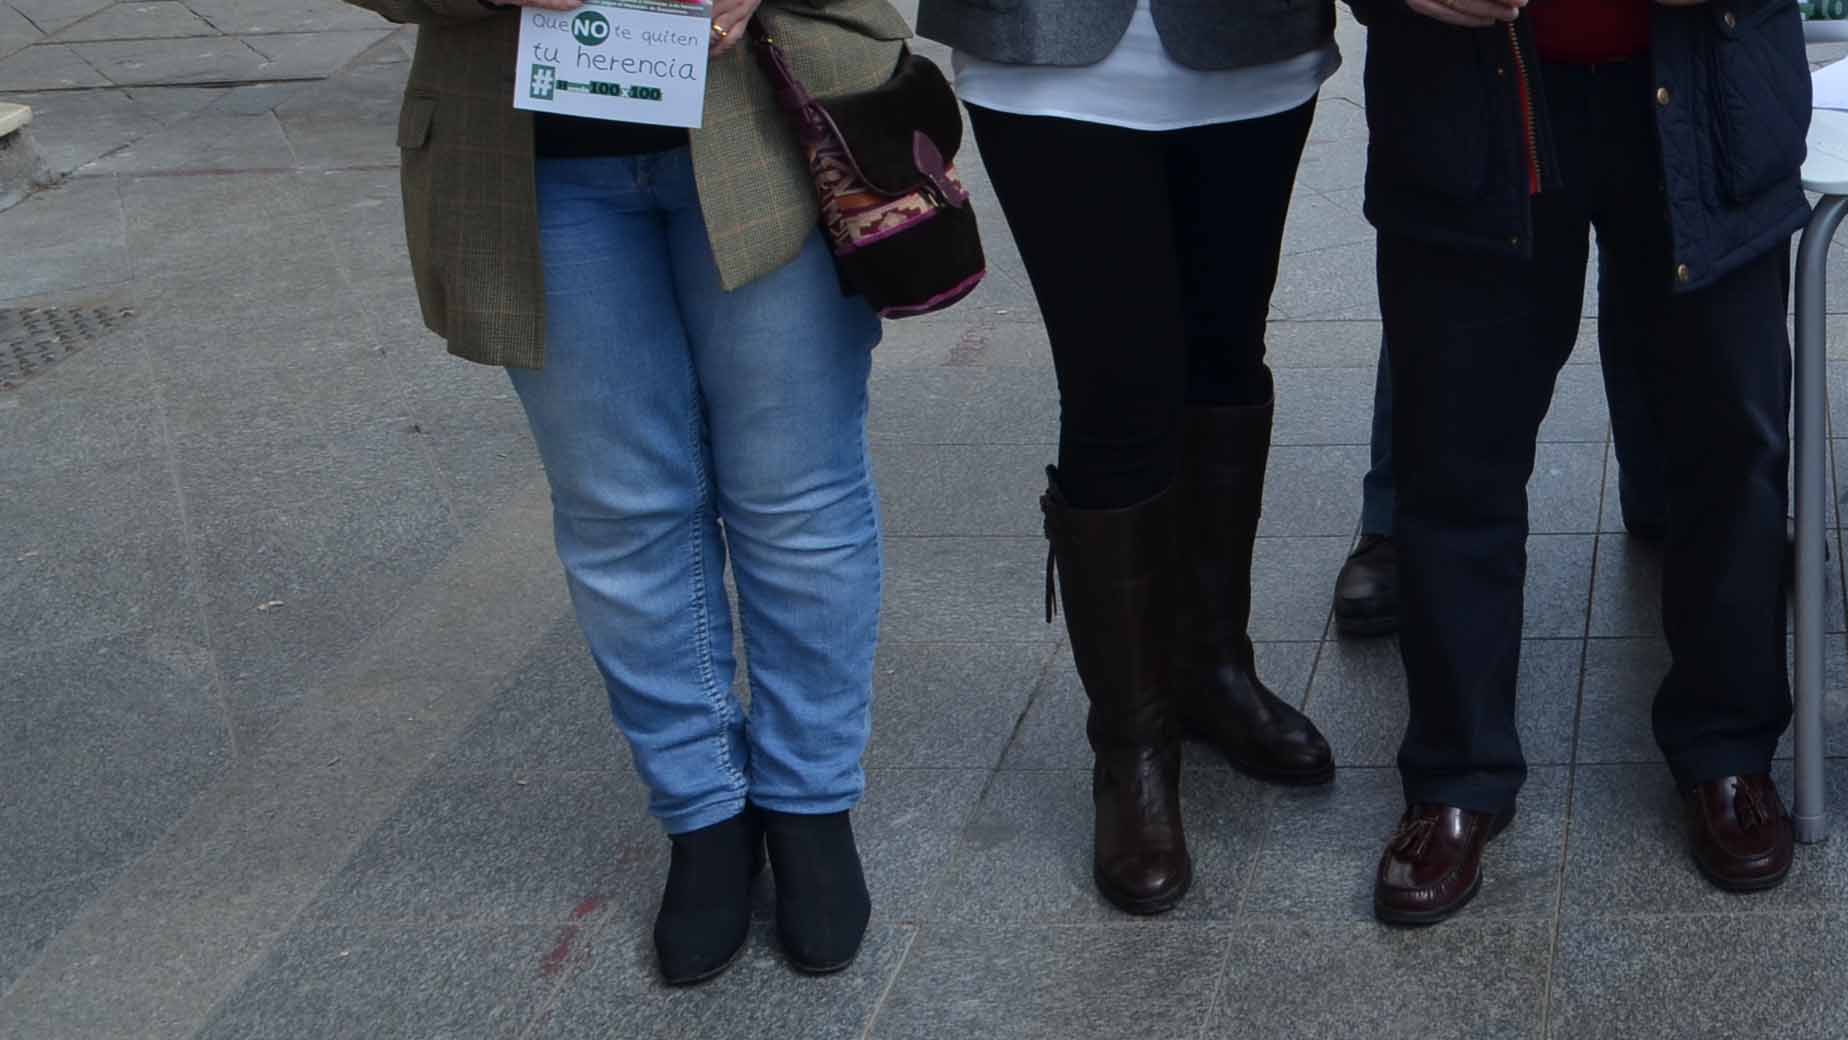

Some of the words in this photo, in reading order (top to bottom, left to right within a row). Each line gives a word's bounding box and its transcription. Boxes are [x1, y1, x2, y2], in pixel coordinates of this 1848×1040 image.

[532, 13, 569, 34] Que
[573, 19, 609, 39] NO
[614, 23, 632, 40] te
[641, 27, 698, 46] quiten
[533, 42, 560, 65] tu
[576, 44, 697, 81] herencia
